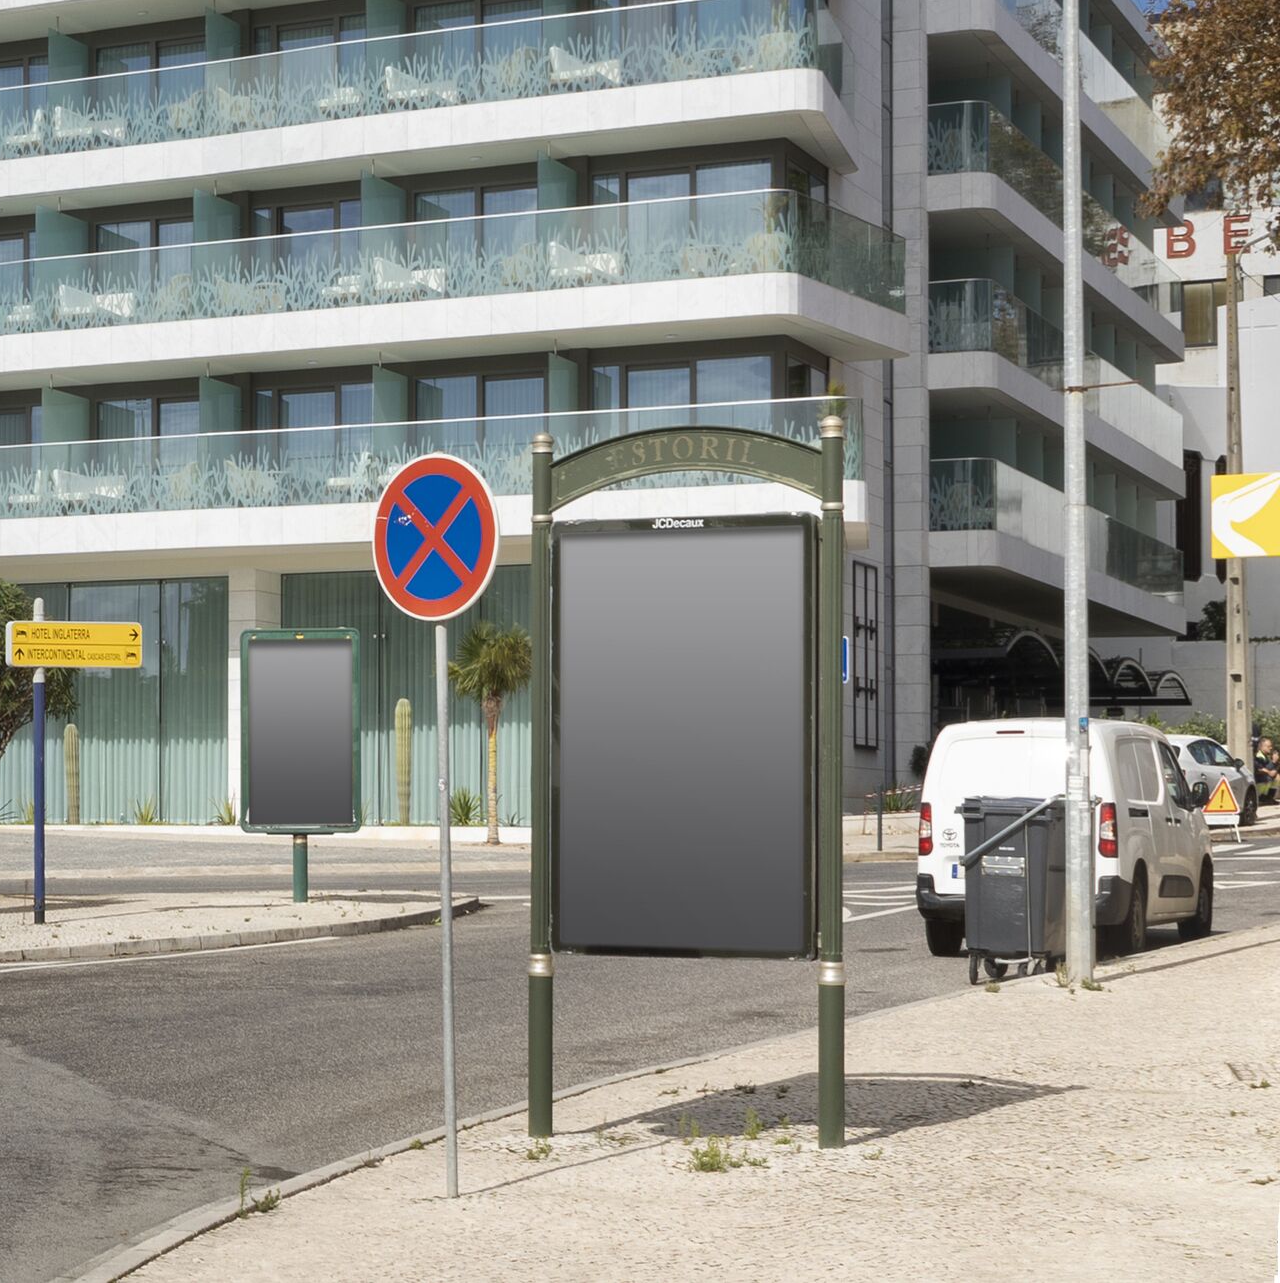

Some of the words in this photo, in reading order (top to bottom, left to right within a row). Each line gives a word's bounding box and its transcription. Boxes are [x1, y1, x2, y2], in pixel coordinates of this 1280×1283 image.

[606, 435, 756, 470] ESTORIL
[652, 518, 705, 530] JCDecaux
[31, 628, 51, 640] HOTEL
[52, 628, 91, 641] INGLATERRA
[27, 648, 86, 661] INTERCONTINENTAL
